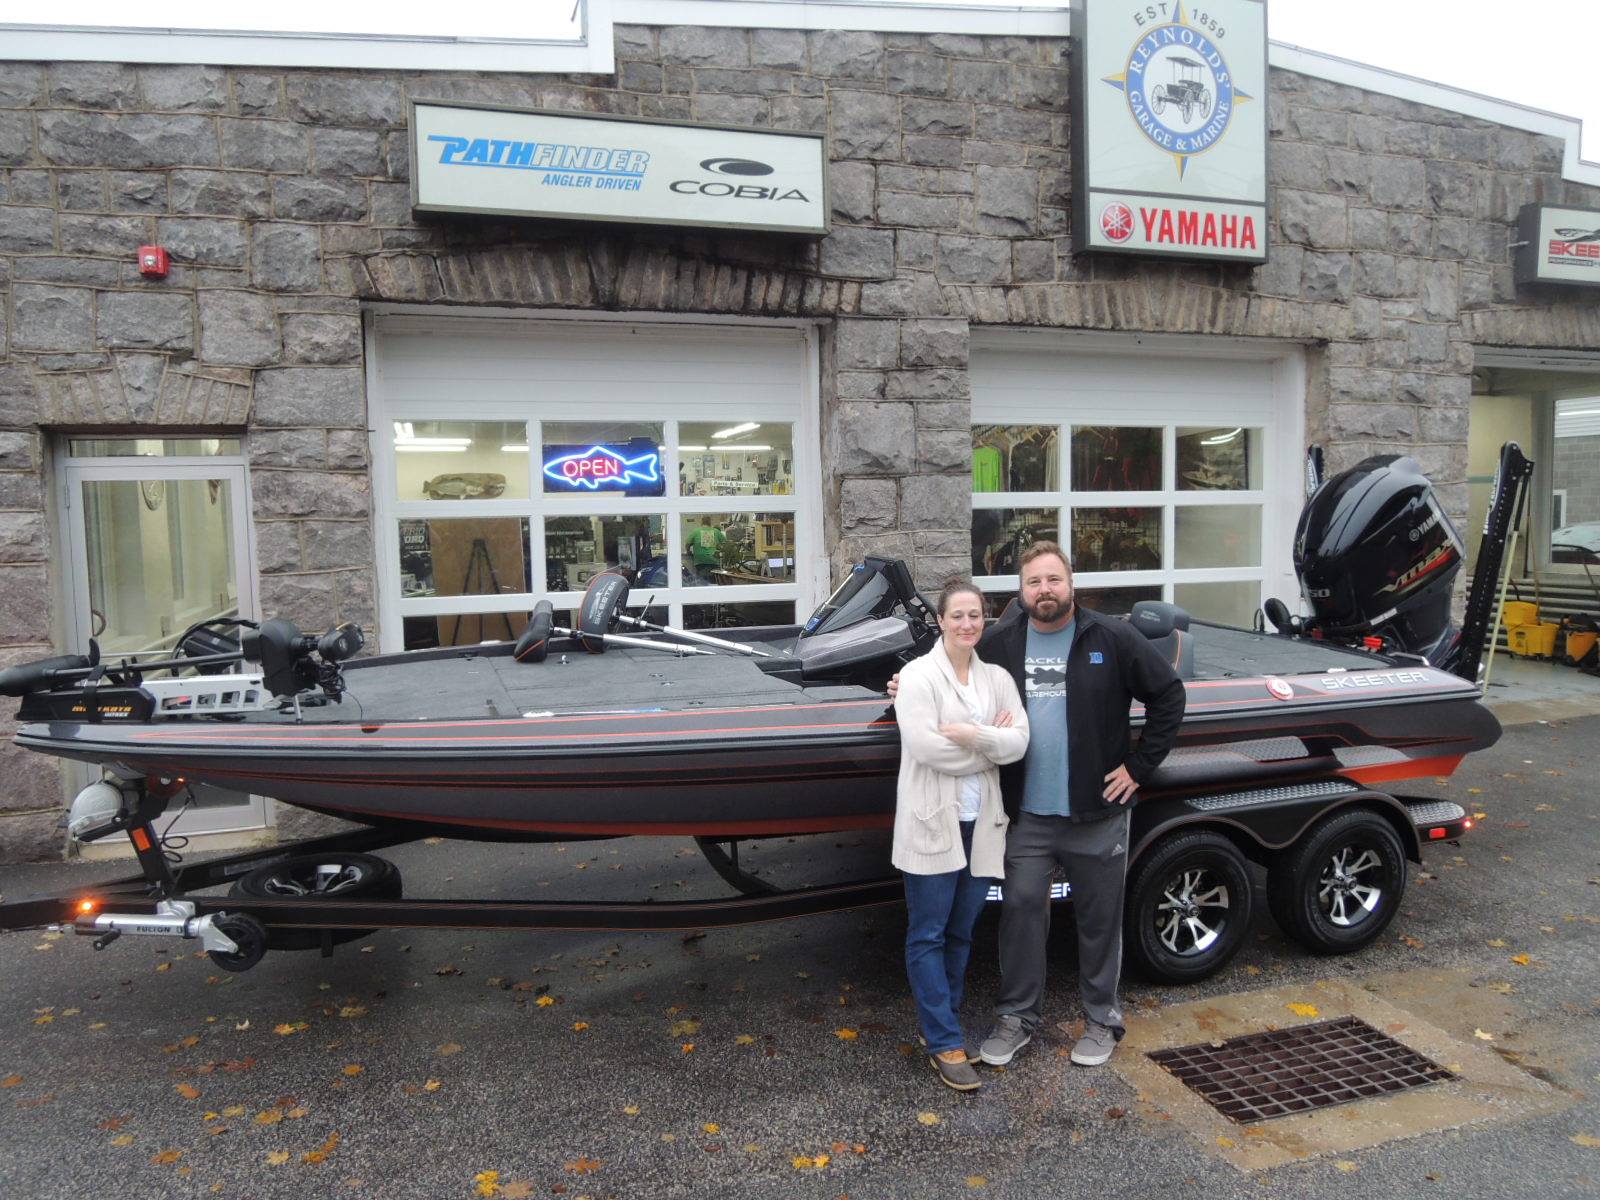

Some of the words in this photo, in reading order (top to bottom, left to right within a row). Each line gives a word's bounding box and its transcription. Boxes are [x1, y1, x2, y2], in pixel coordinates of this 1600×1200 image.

[1132, 2, 1168, 27] EST
[1191, 8, 1226, 39] 1859
[1129, 90, 1172, 148] GARAGE
[1176, 138, 1187, 151] &
[1190, 99, 1230, 150] MARINE
[427, 135, 650, 175] PATHFINDER
[541, 174, 593, 189] ANGLER
[595, 177, 642, 192] DRIVEN
[669, 180, 811, 203] COBIA
[1140, 207, 1257, 250] YAMAHA
[562, 458, 619, 478] OPEN
[1025, 657, 1066, 665] ACKL
[1320, 671, 1430, 690] SKEETER
[1025, 690, 1067, 698] AREHOUS
